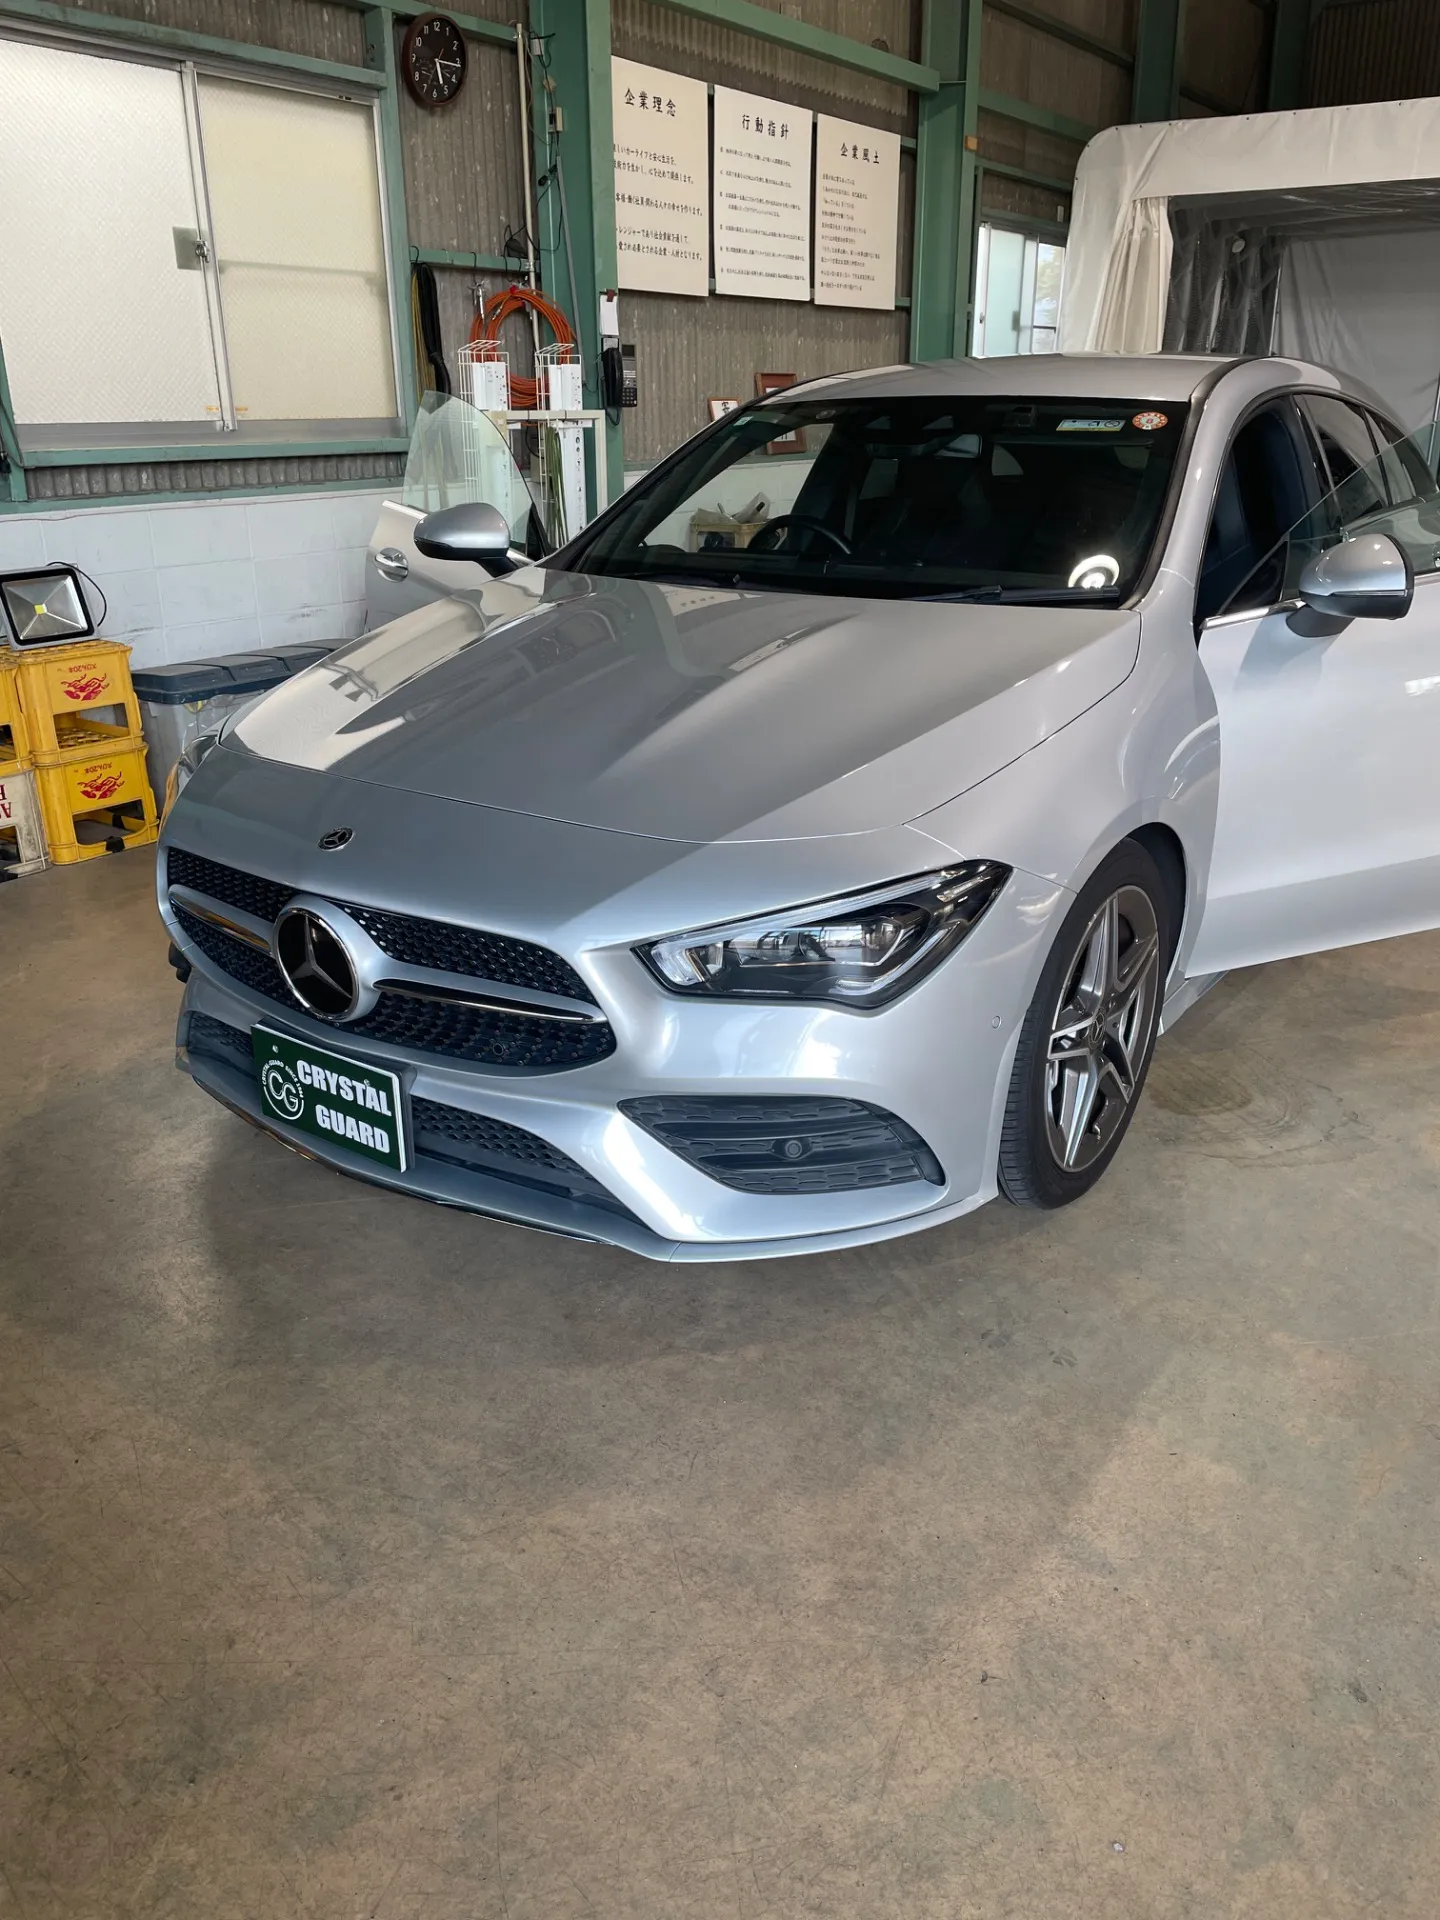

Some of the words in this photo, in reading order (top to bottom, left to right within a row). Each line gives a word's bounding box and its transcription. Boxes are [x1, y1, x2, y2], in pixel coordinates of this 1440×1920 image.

[424, 26, 429, 34] 11
[433, 22, 440, 32] 12
[446, 28, 449, 36] 1
[415, 37, 422, 47] 10
[453, 41, 459, 50] 2
[411, 54, 416, 63] 9
[455, 58, 460, 66] 3
[414, 72, 419, 81] 8
[422, 84, 427, 93] 7
[443, 86, 448, 95] 5
[432, 89, 437, 98] 6
[624, 87, 676, 117] 企業理念
[741, 113, 789, 140] 行動指針
[840, 141, 880, 165] 企業風土
[296, 1060, 392, 1117] CRYSTAL
[315, 1104, 390, 1154] GUARD
